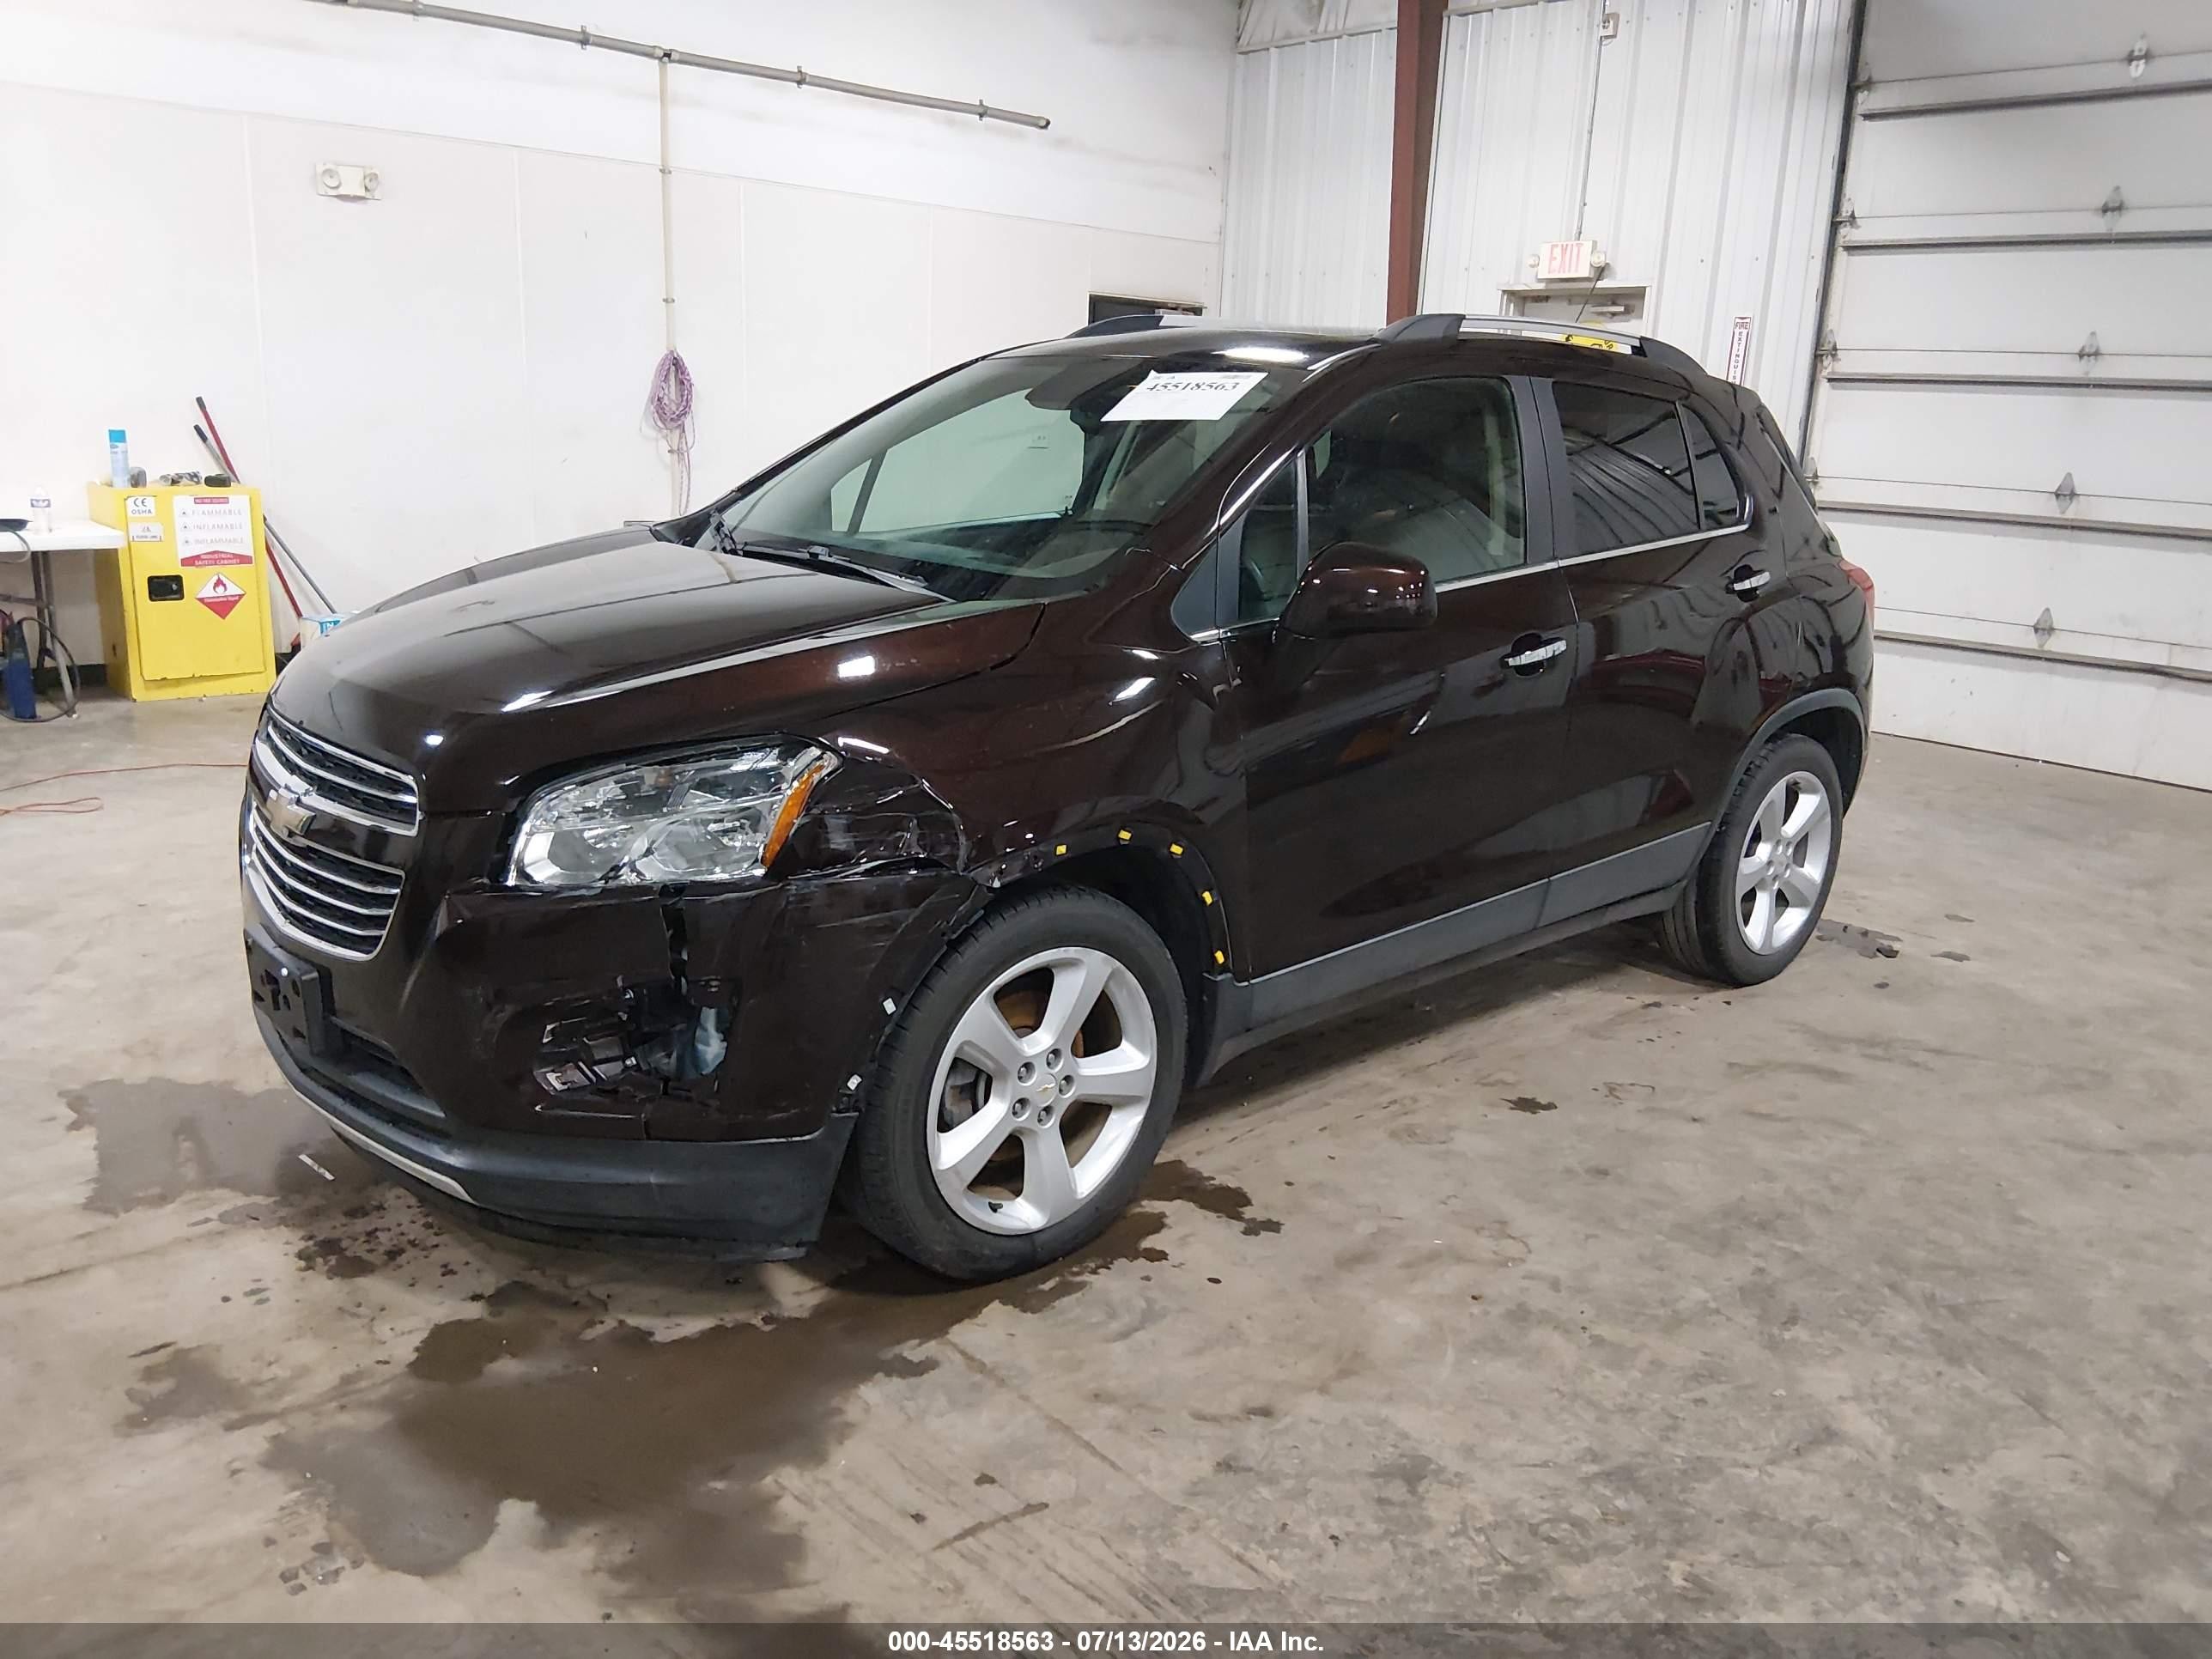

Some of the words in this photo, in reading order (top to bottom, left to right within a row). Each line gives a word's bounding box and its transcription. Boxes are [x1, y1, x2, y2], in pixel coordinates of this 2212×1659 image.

[1548, 242, 1583, 274] EXIT
[1735, 321, 1749, 330] FIRE
[1146, 382, 1240, 391] 45518563
